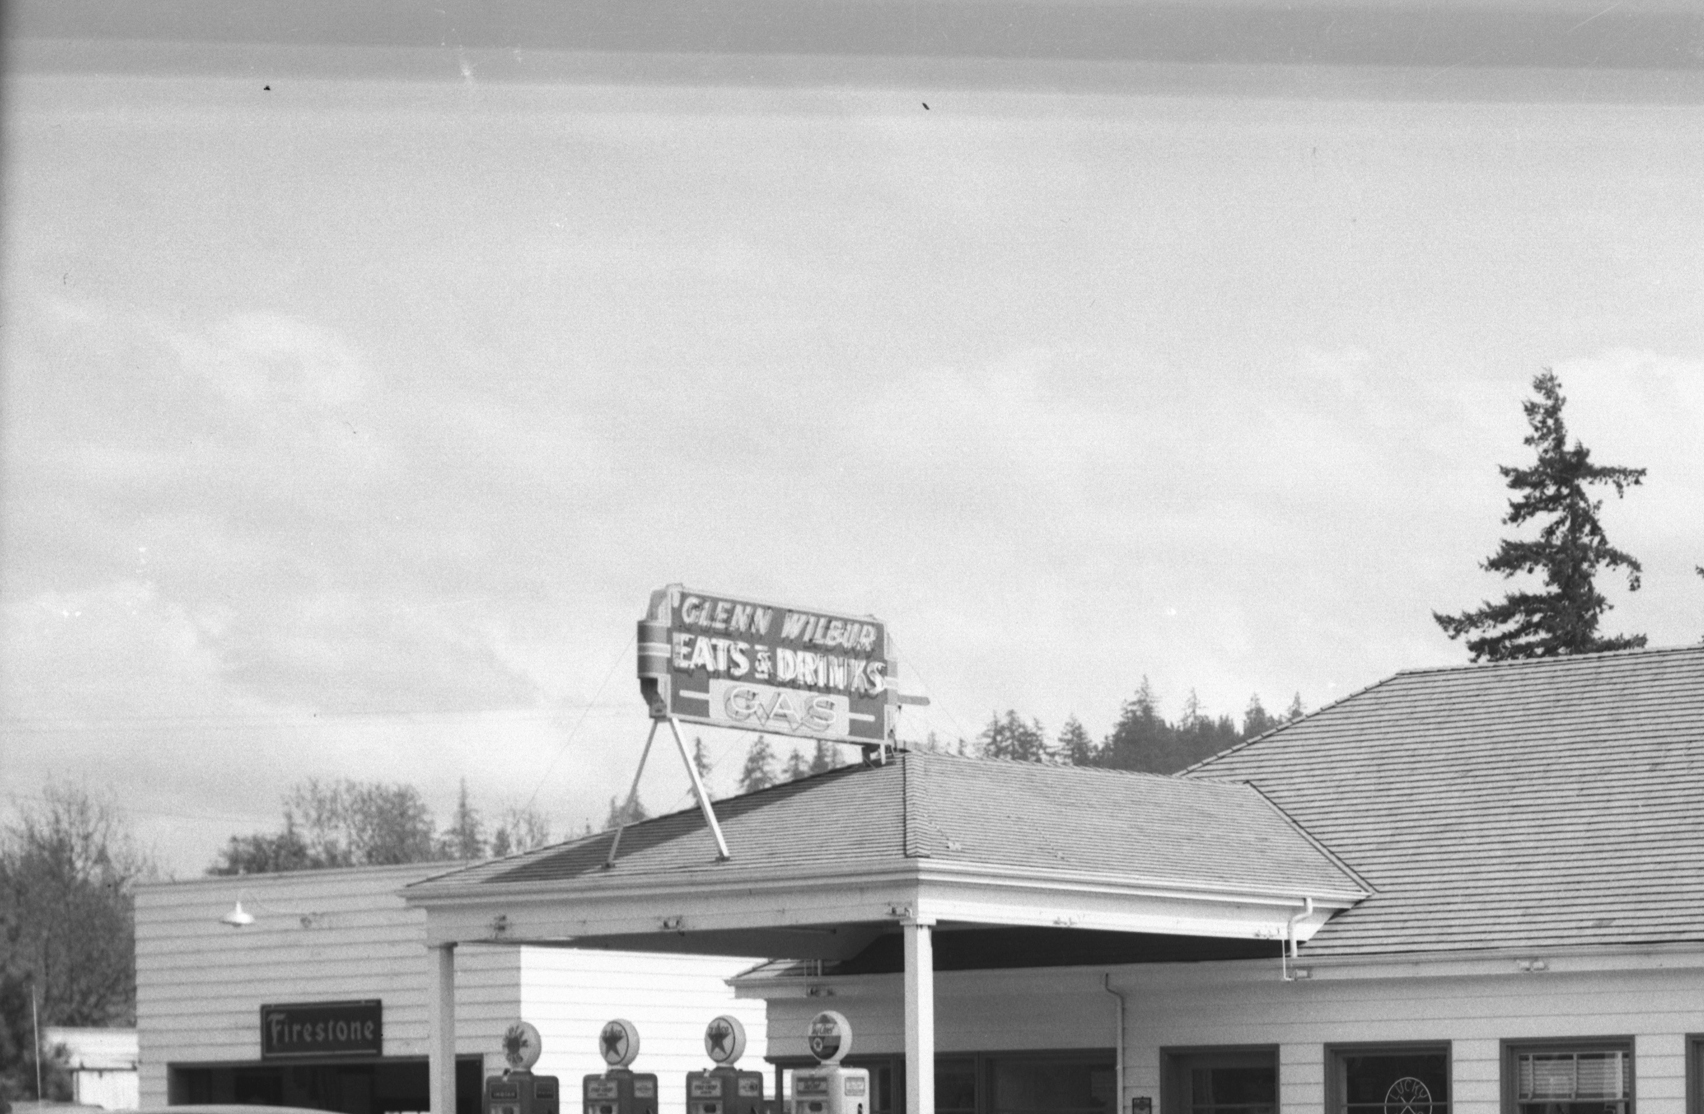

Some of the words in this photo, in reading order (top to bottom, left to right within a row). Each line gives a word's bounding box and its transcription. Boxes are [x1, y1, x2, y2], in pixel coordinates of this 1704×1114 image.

[682, 596, 773, 636] GLENN
[781, 612, 878, 652] WILBUR
[672, 632, 750, 677] EATS
[776, 647, 887, 696] DRINKS
[724, 684, 838, 732] GAS
[267, 1012, 375, 1046] Firestone
[1390, 1079, 1428, 1100] LUCKY
